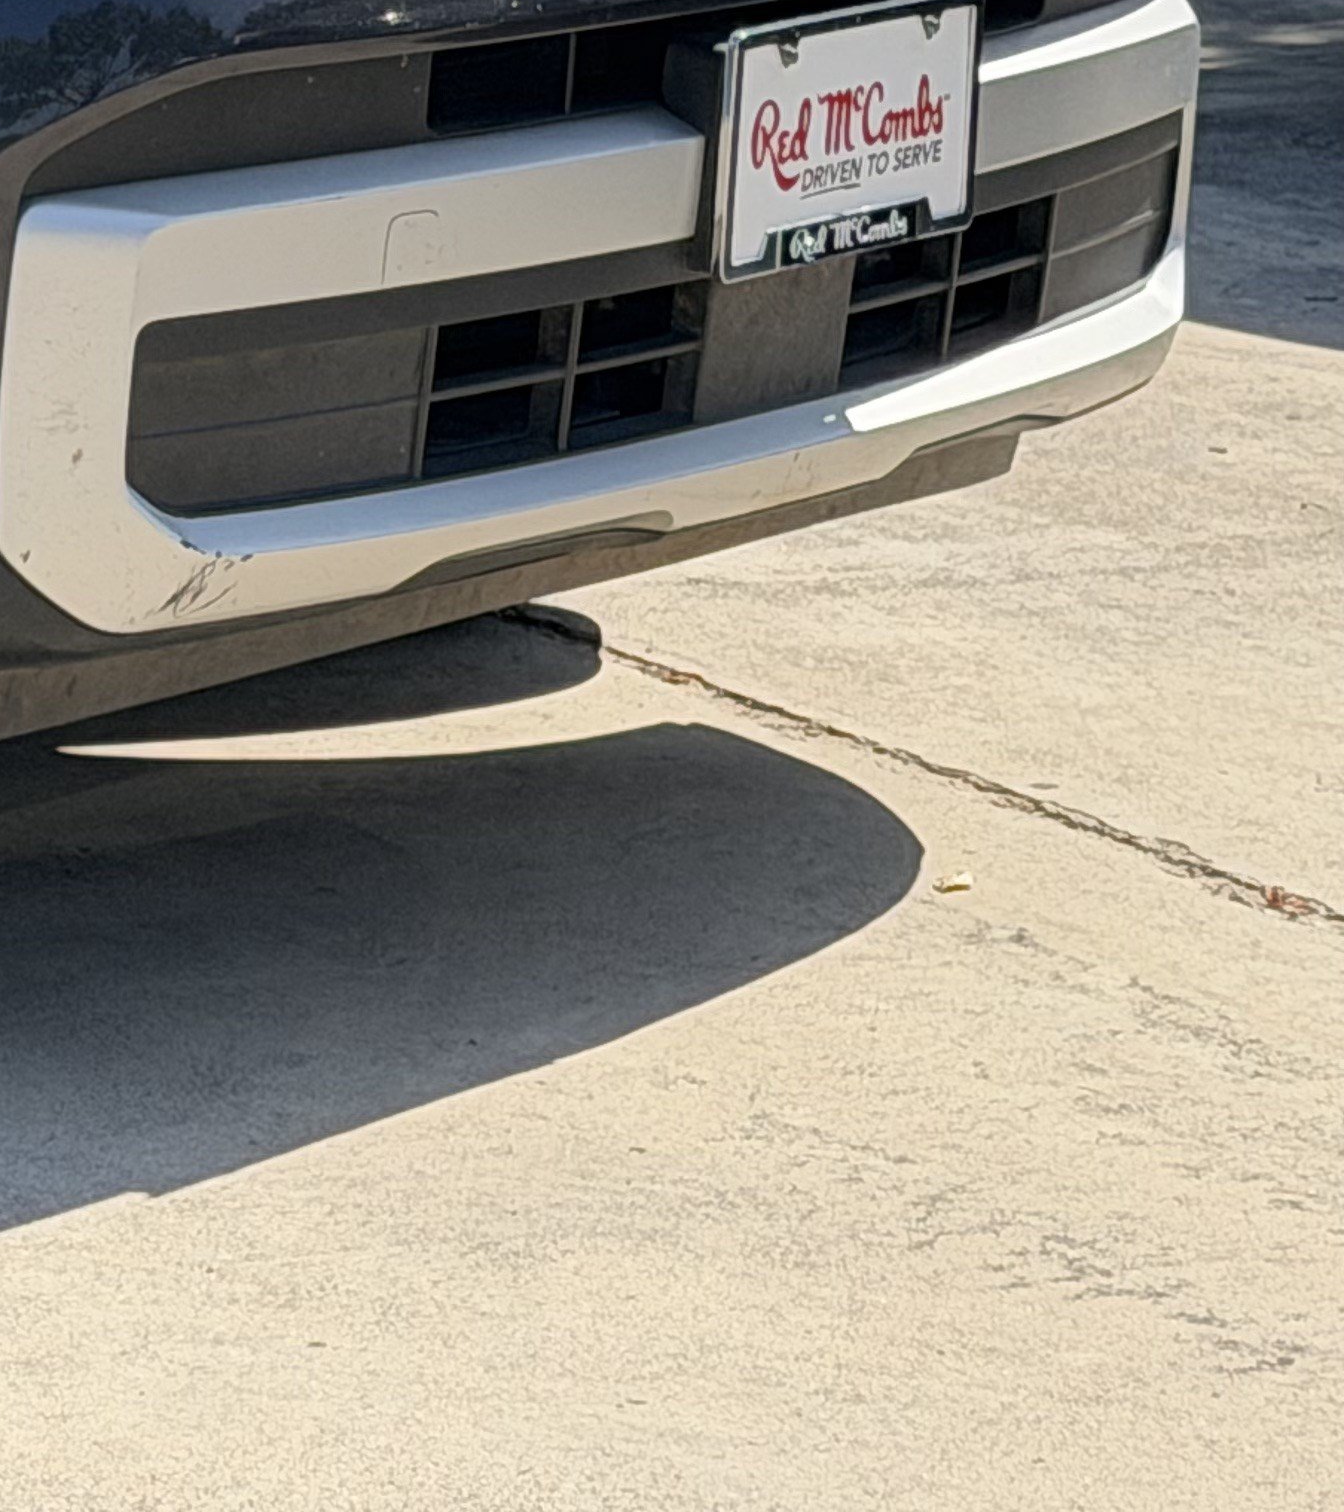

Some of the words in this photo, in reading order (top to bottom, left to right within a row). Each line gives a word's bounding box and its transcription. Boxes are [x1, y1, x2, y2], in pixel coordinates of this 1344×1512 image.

[751, 97, 811, 192] Red
[817, 74, 943, 156] McCombs
[801, 156, 863, 192] DRIVEN
[867, 150, 890, 178] TO
[892, 139, 944, 173] SERVE
